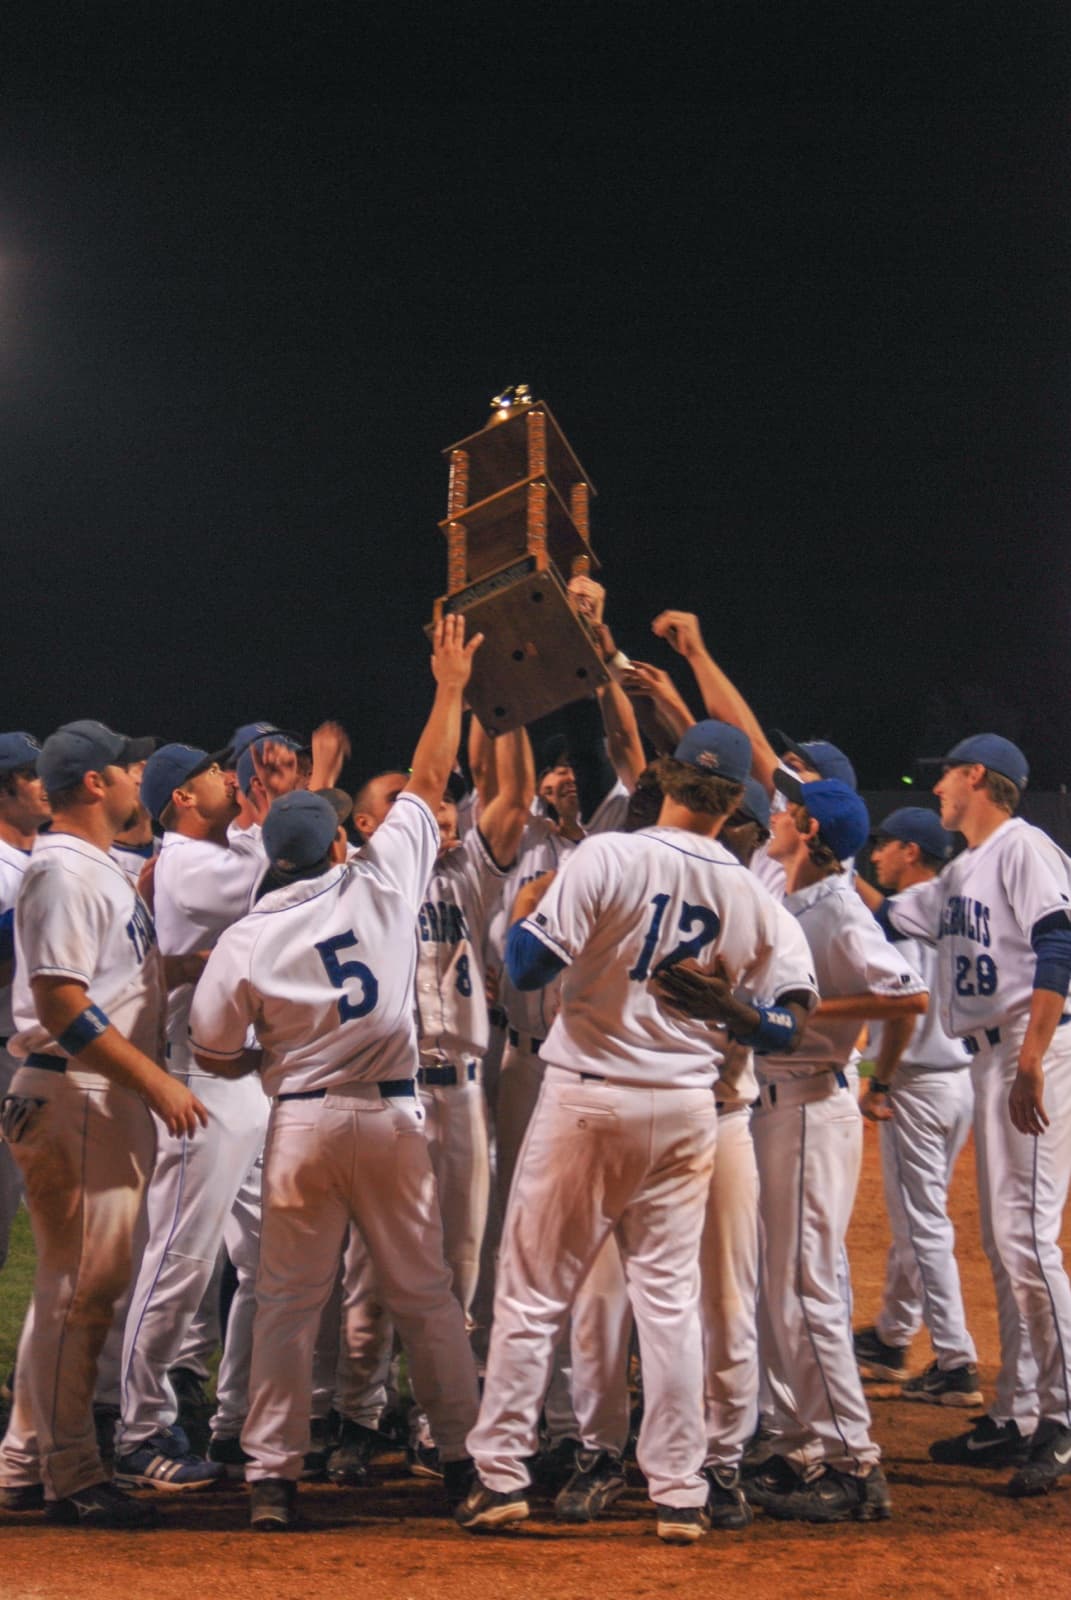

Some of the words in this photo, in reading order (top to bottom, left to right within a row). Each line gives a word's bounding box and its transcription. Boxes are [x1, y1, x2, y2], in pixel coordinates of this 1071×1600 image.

[313, 928, 379, 1024] 5
[455, 954, 472, 998] 8
[630, 893, 720, 981] 12
